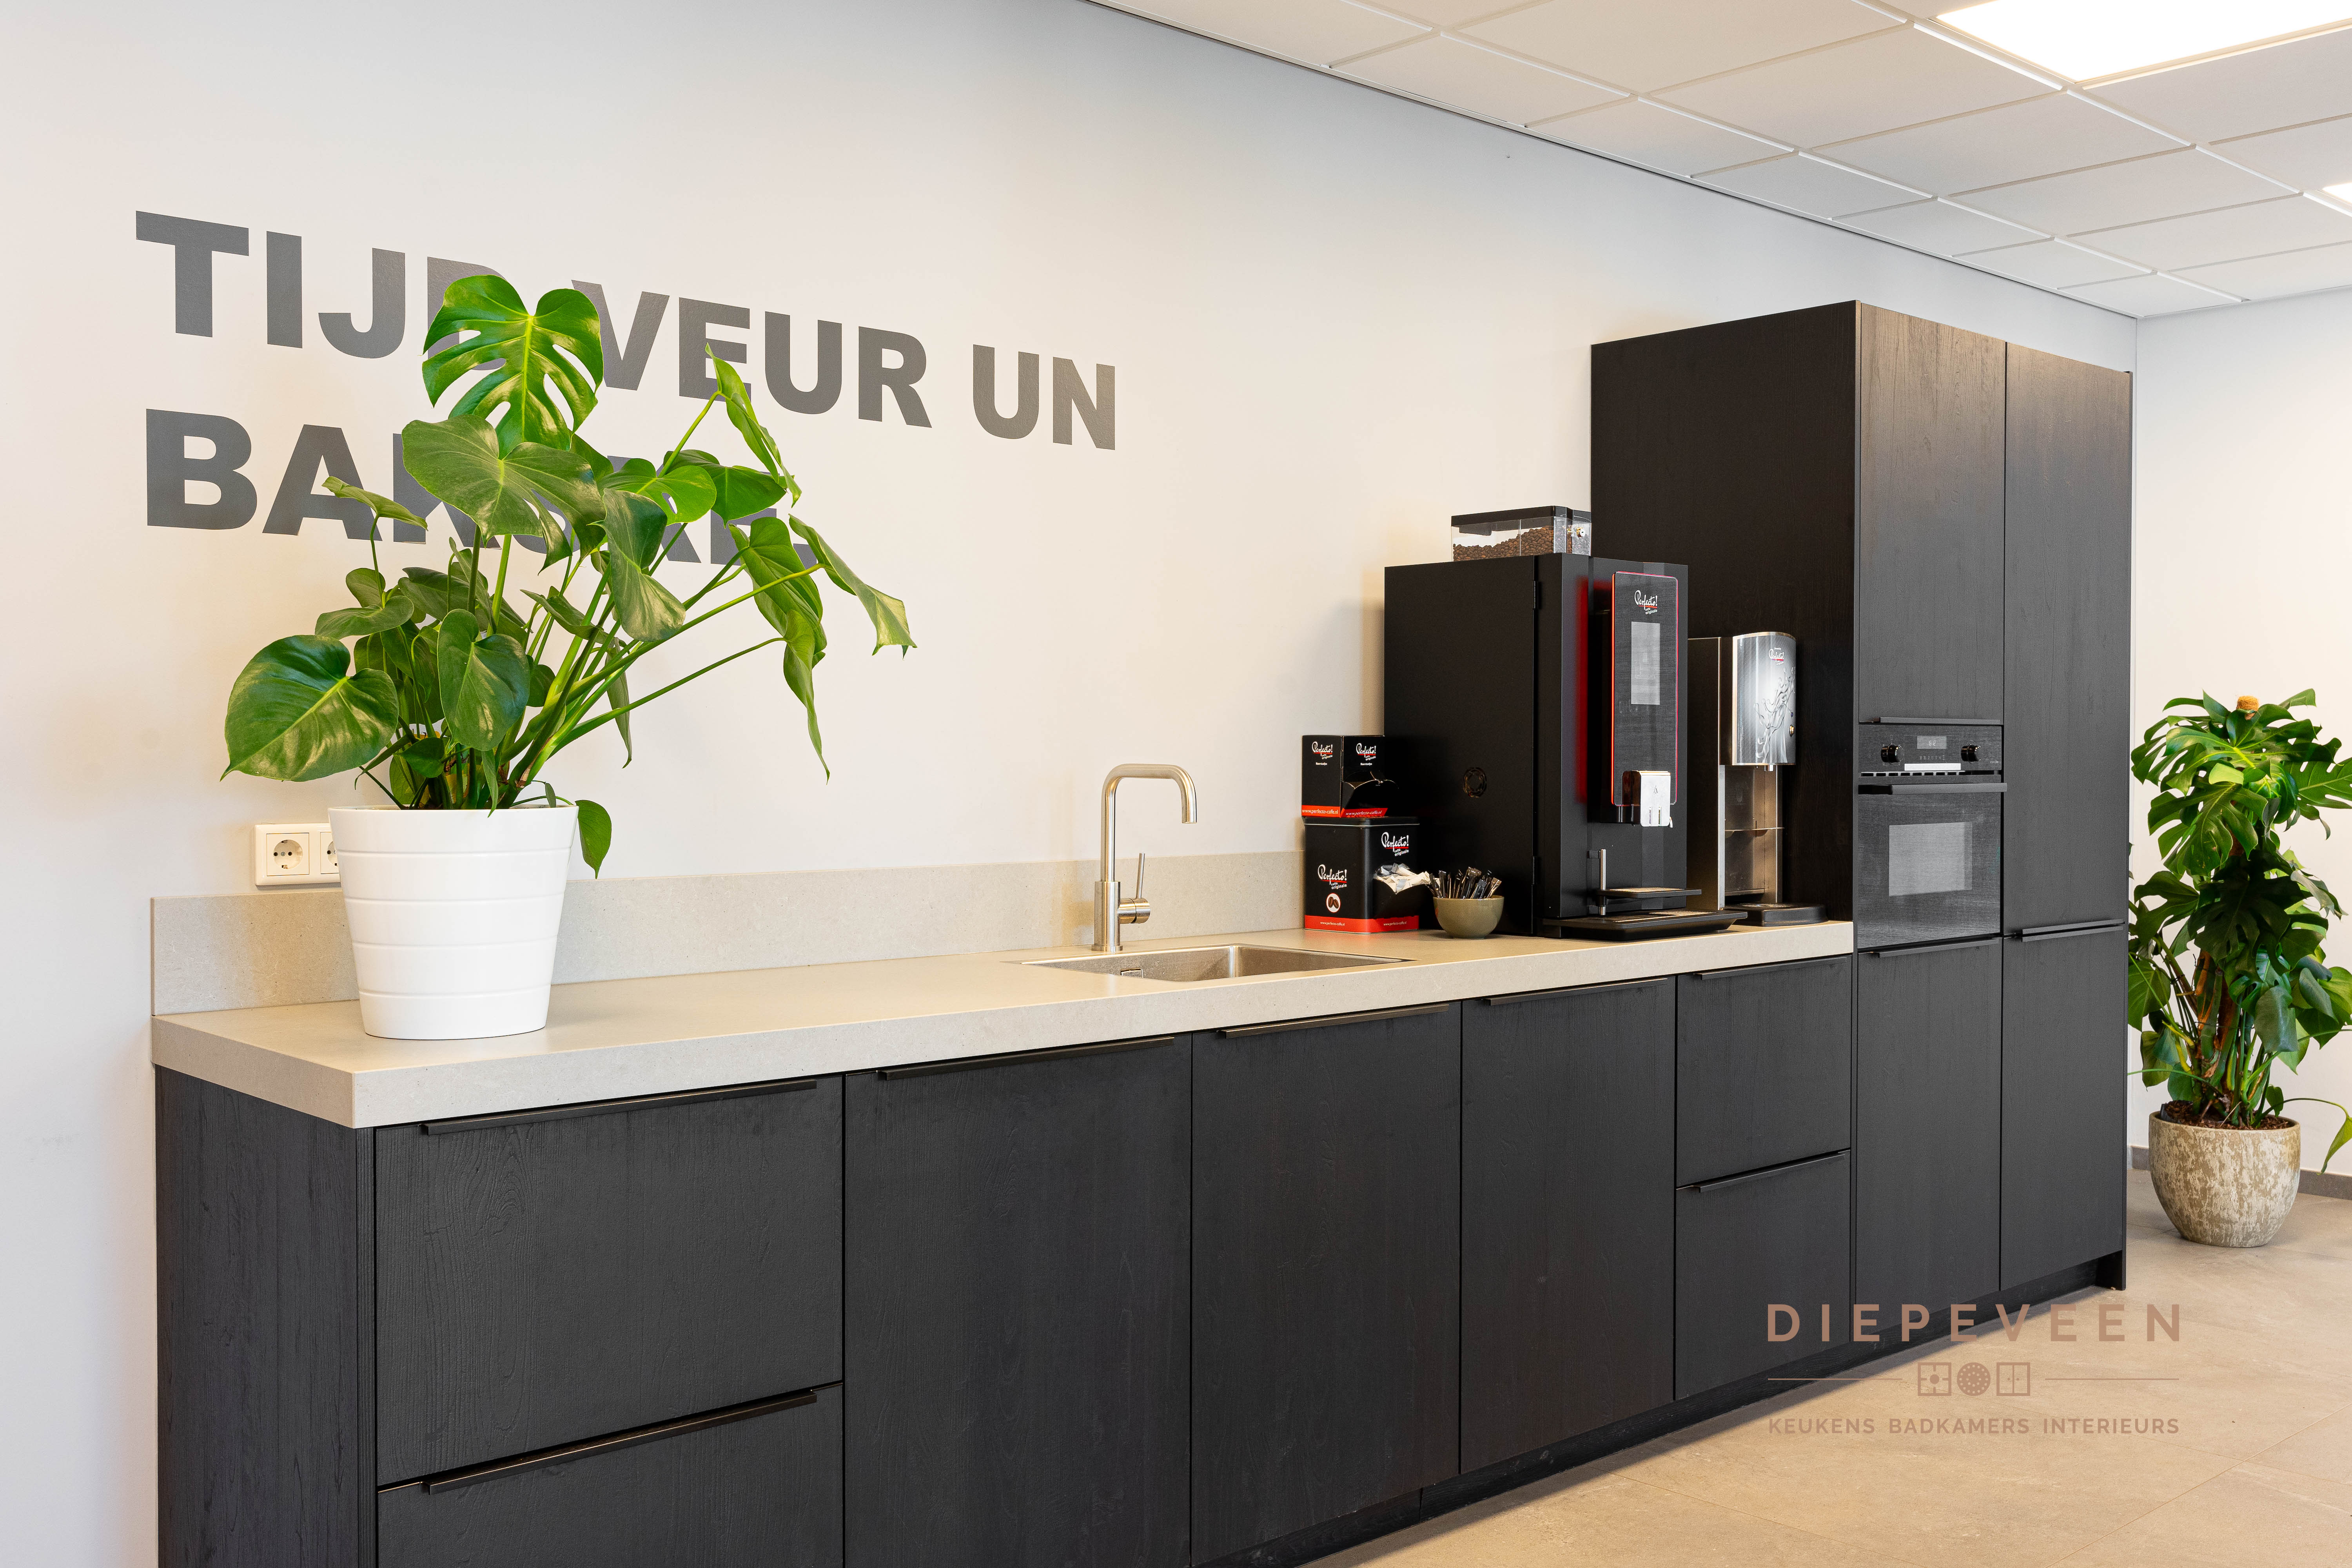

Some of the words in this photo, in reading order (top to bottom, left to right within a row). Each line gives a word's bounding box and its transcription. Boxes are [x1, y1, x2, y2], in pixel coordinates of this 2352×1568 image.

[571, 279, 932, 428] VEUR
[973, 344, 1116, 450] UN
[1634, 590, 1658, 610] Perfecto!
[1312, 741, 1333, 756] Perfecto!
[1356, 743, 1376, 758] Perfecto!
[1381, 832, 1409, 852] Perfecto!
[1318, 864, 1347, 885] Perfecto!
